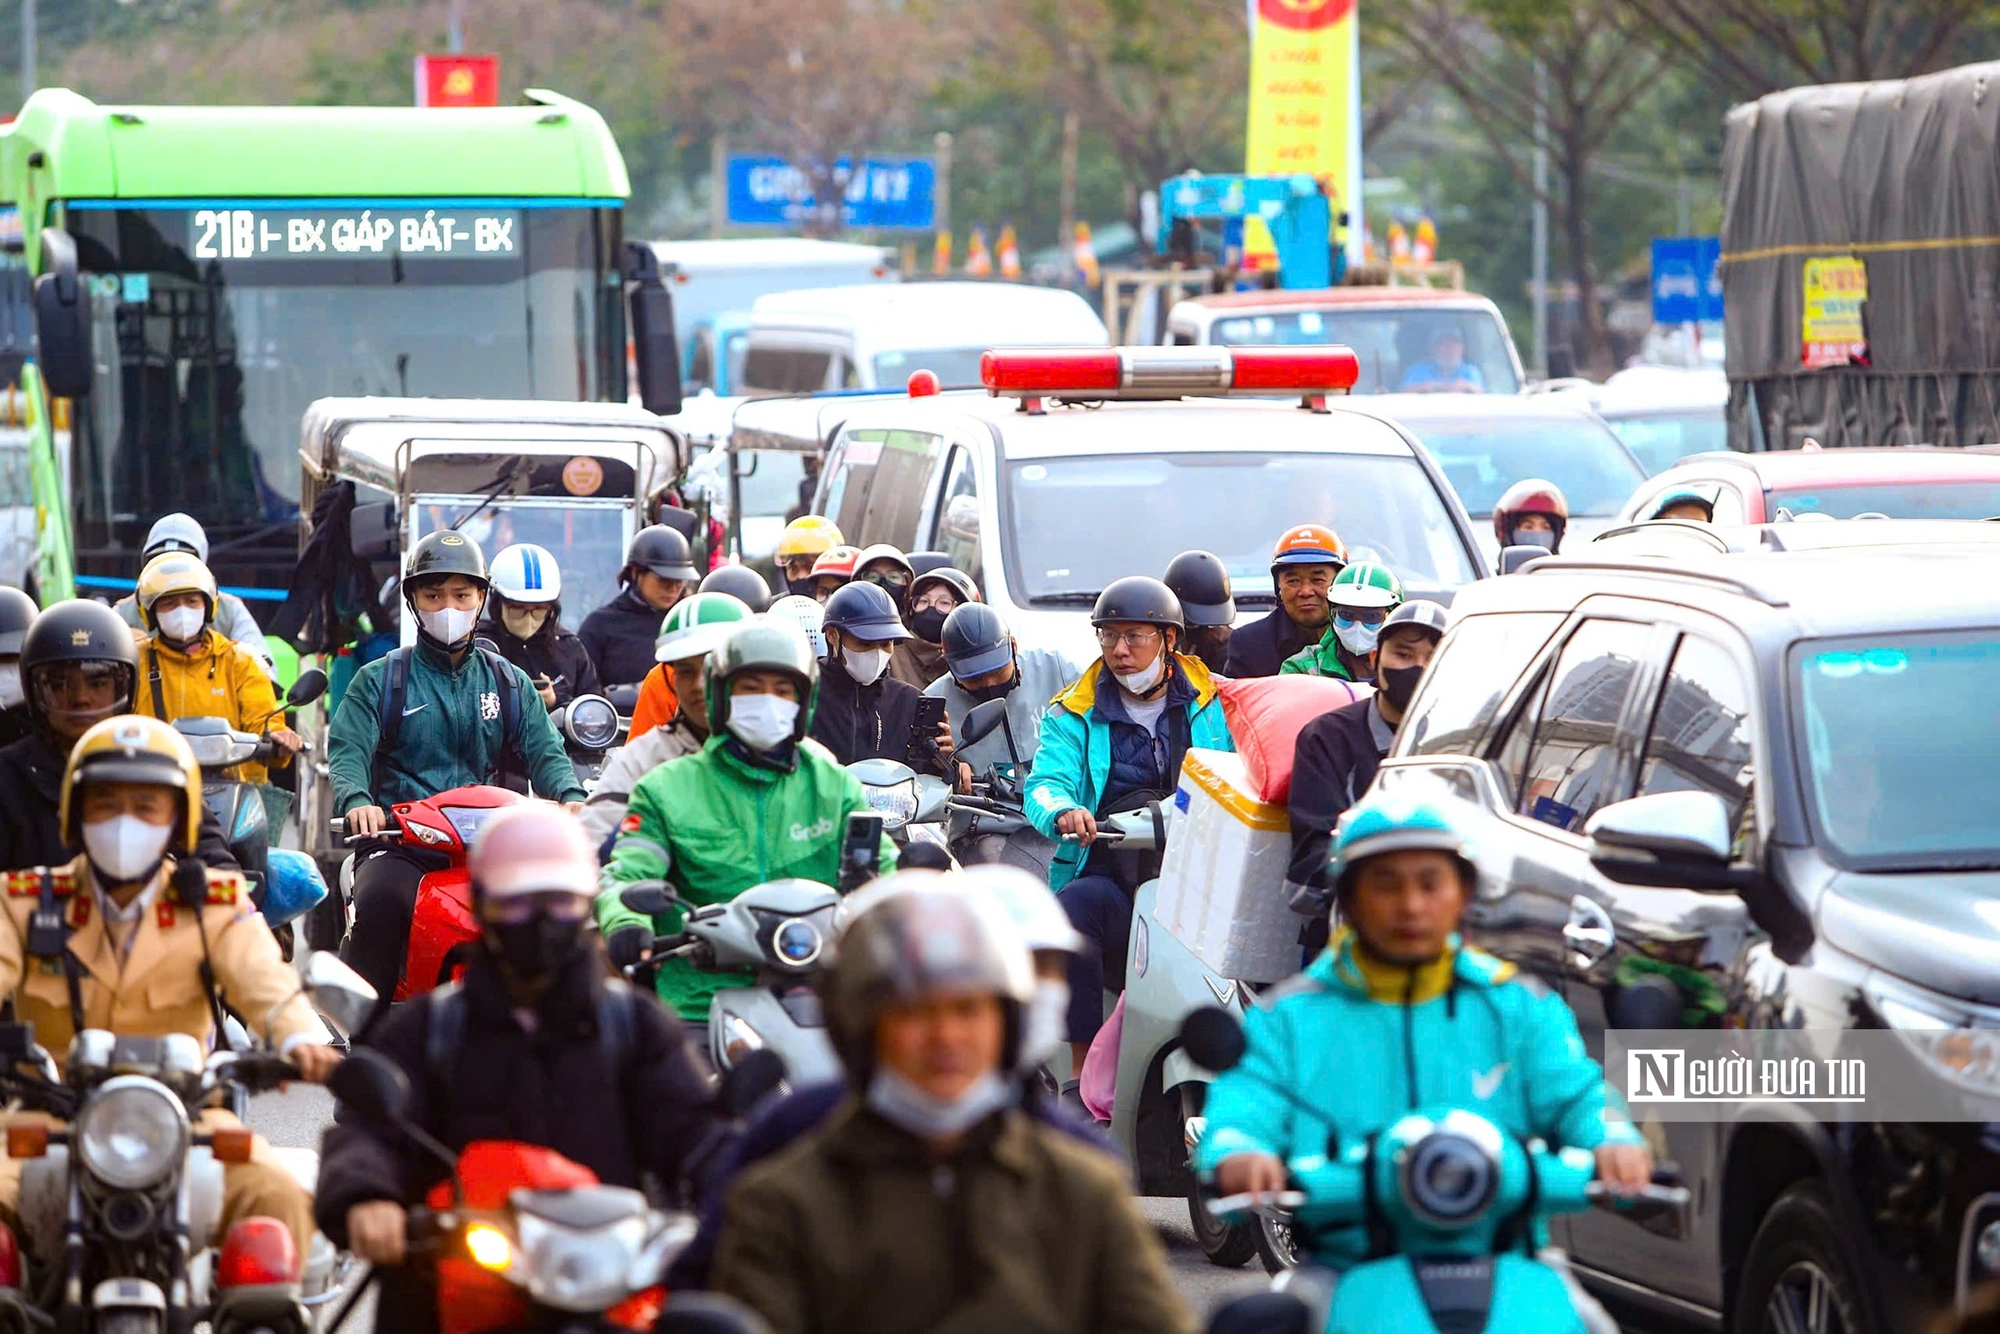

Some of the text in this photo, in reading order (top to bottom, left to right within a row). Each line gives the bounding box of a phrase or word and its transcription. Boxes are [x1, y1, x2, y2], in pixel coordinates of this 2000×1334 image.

[195, 210, 254, 258] 21B
[288, 218, 326, 252] BX
[332, 210, 394, 252] GIÁP
[475, 218, 513, 252] BX
[790, 816, 834, 842] Grab
